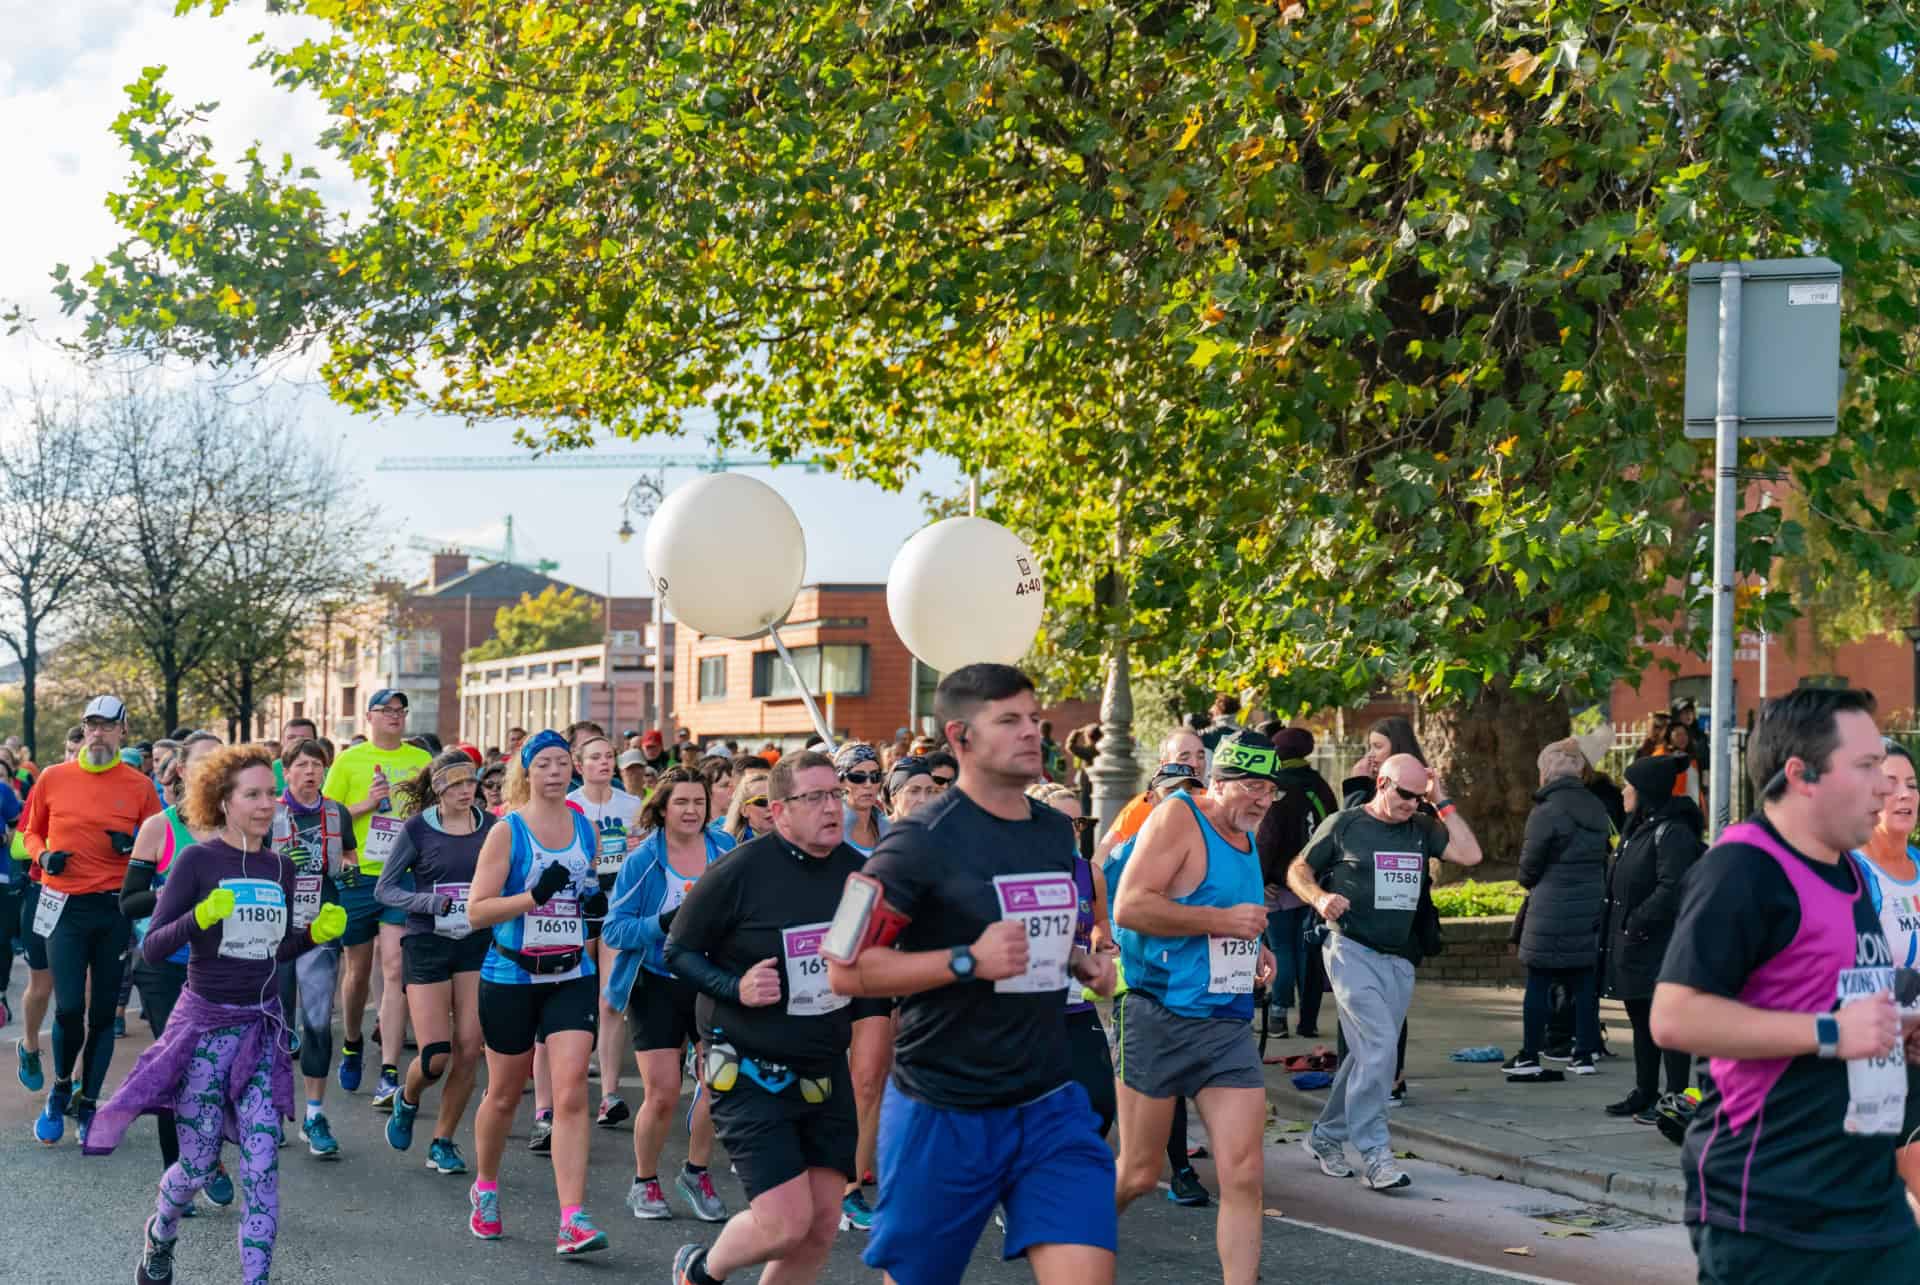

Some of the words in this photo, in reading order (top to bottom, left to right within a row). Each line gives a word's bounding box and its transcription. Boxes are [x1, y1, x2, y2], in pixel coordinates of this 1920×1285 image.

[1016, 577, 1041, 595] 4:40
[1384, 872, 1417, 884] 17586
[237, 907, 282, 924] 11801
[535, 919, 577, 934] 16619
